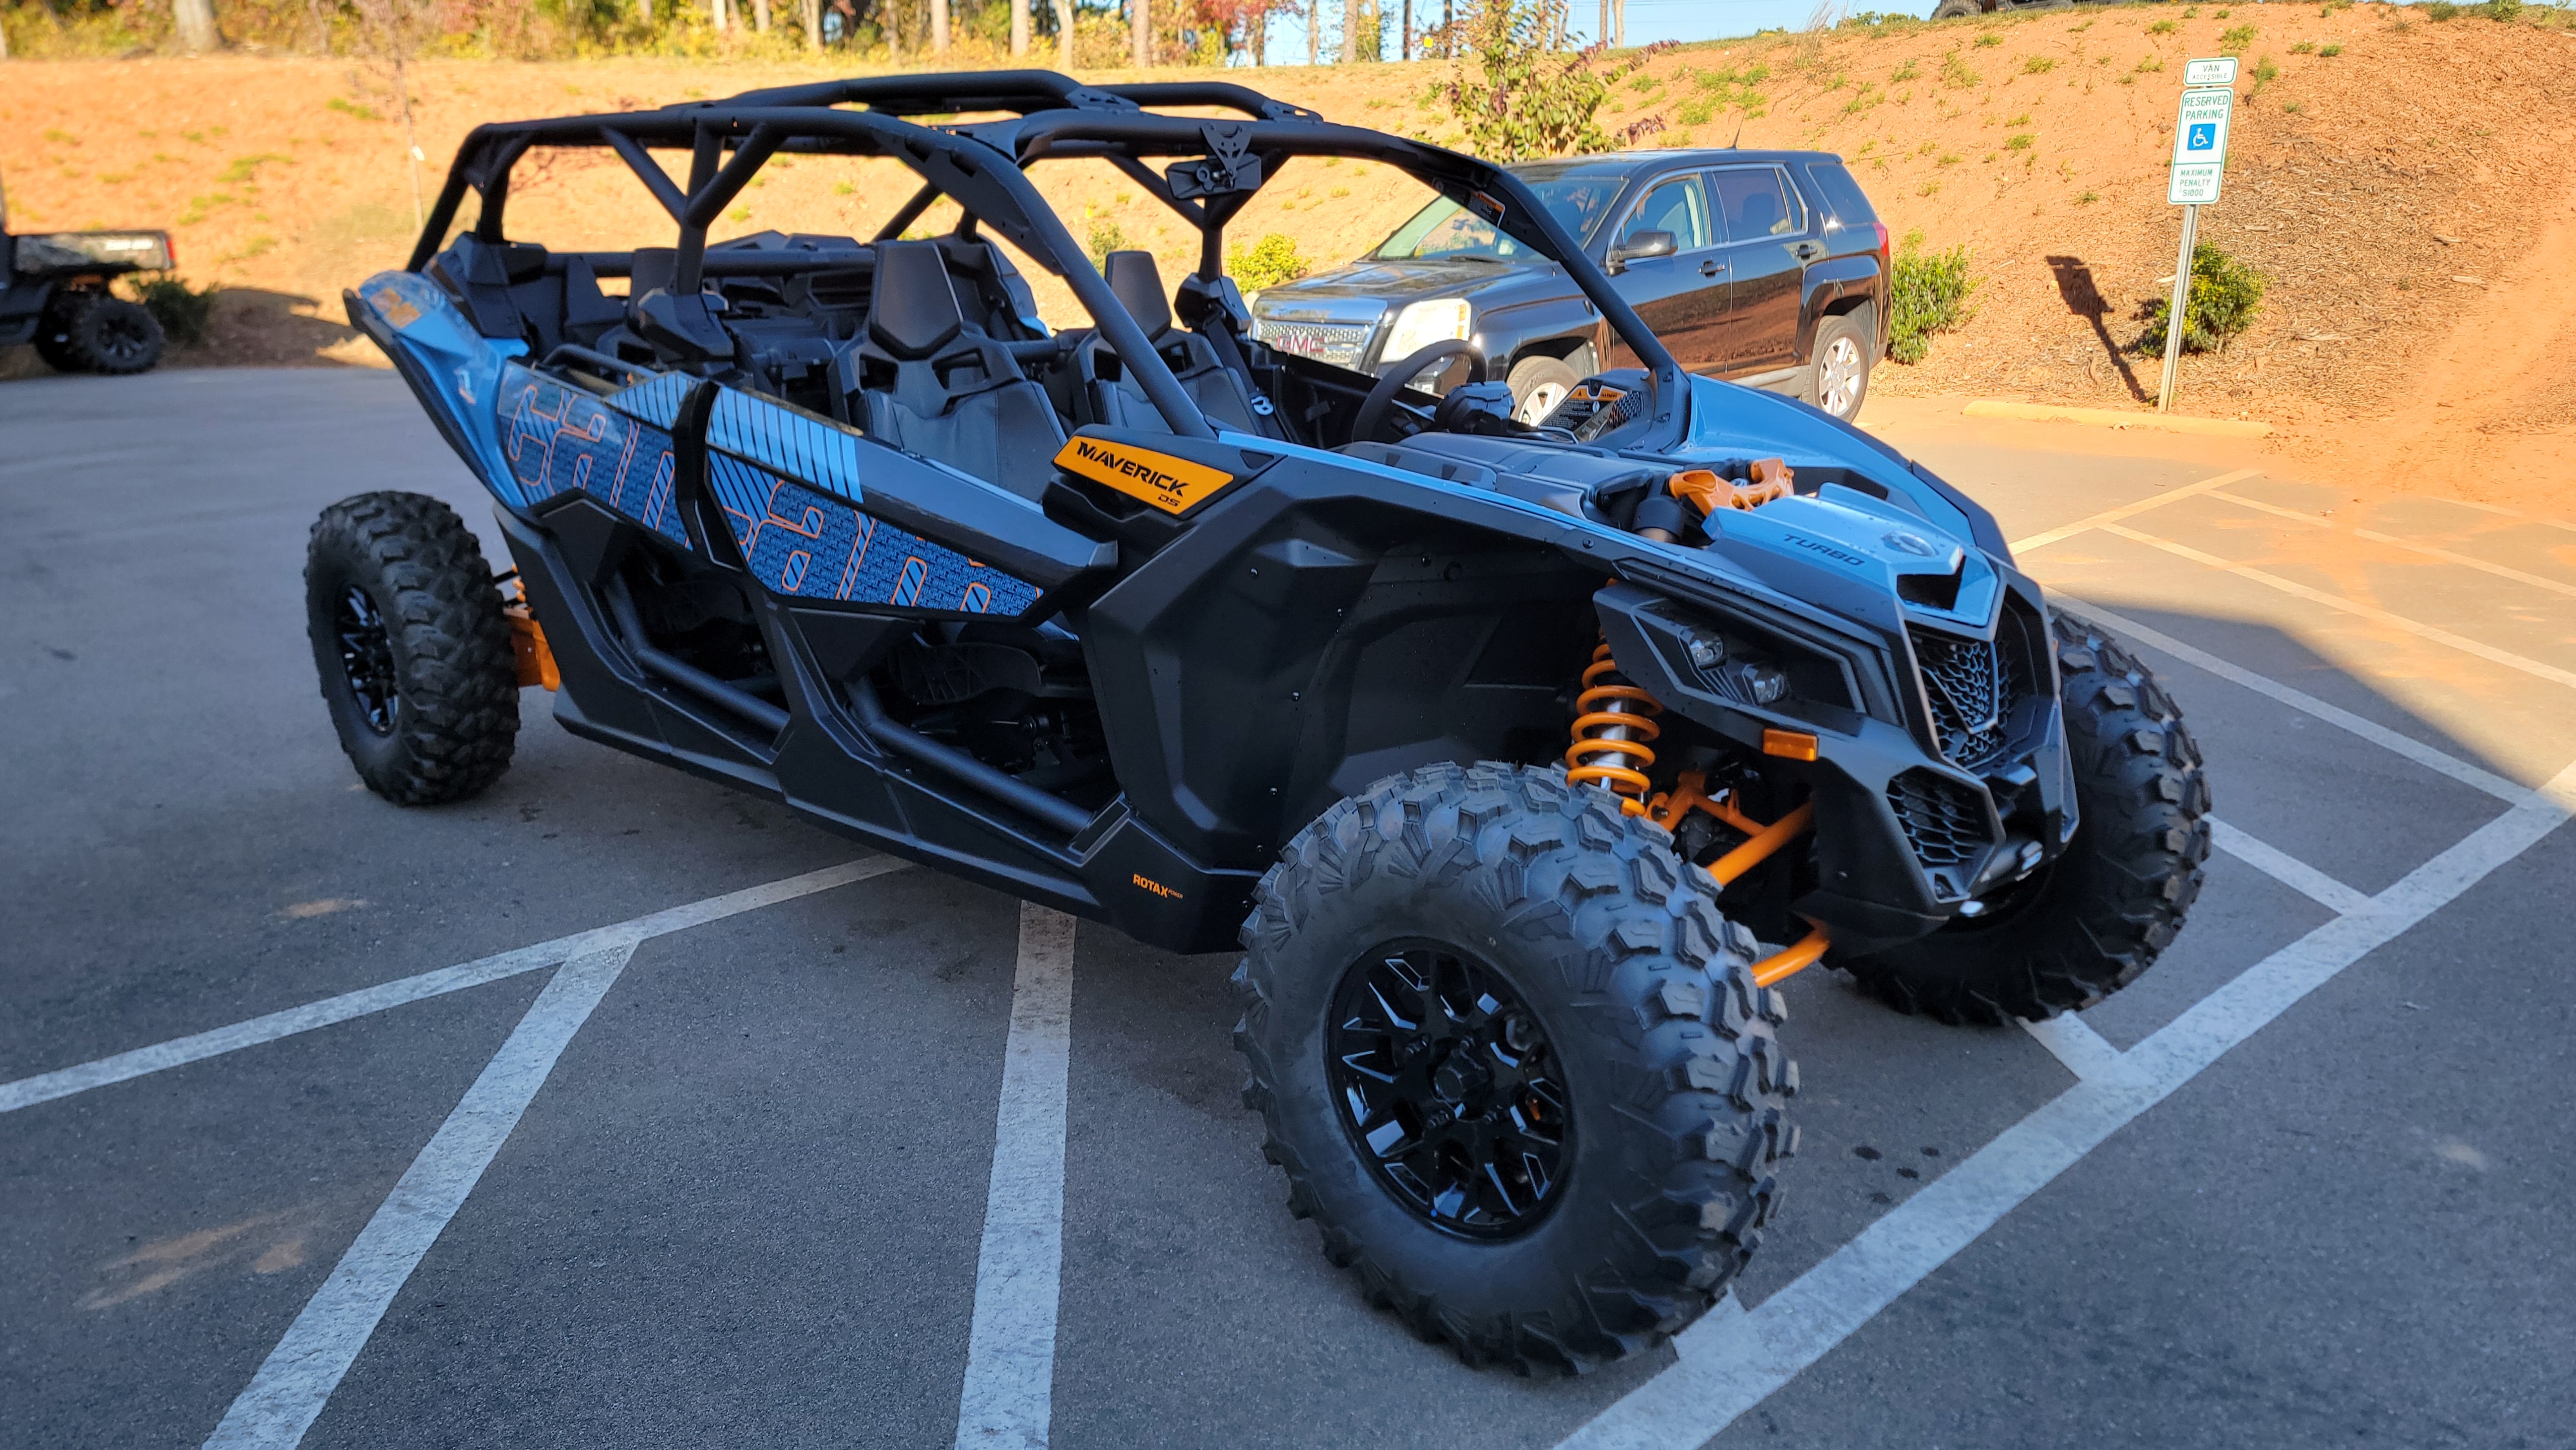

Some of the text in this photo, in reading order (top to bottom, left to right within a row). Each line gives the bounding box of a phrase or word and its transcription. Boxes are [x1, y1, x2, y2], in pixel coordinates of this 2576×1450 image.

[2184, 95, 2228, 108] RESERVED
[2185, 109, 2224, 120] PARKING
[2180, 169, 2213, 177] MAXIMUM
[1277, 335, 1325, 352] GMC
[1076, 441, 1189, 497] MAVERICK
[1157, 494, 1180, 507] DS
[1783, 533, 1865, 566] TURBO
[1133, 873, 1168, 898] ROTAX
